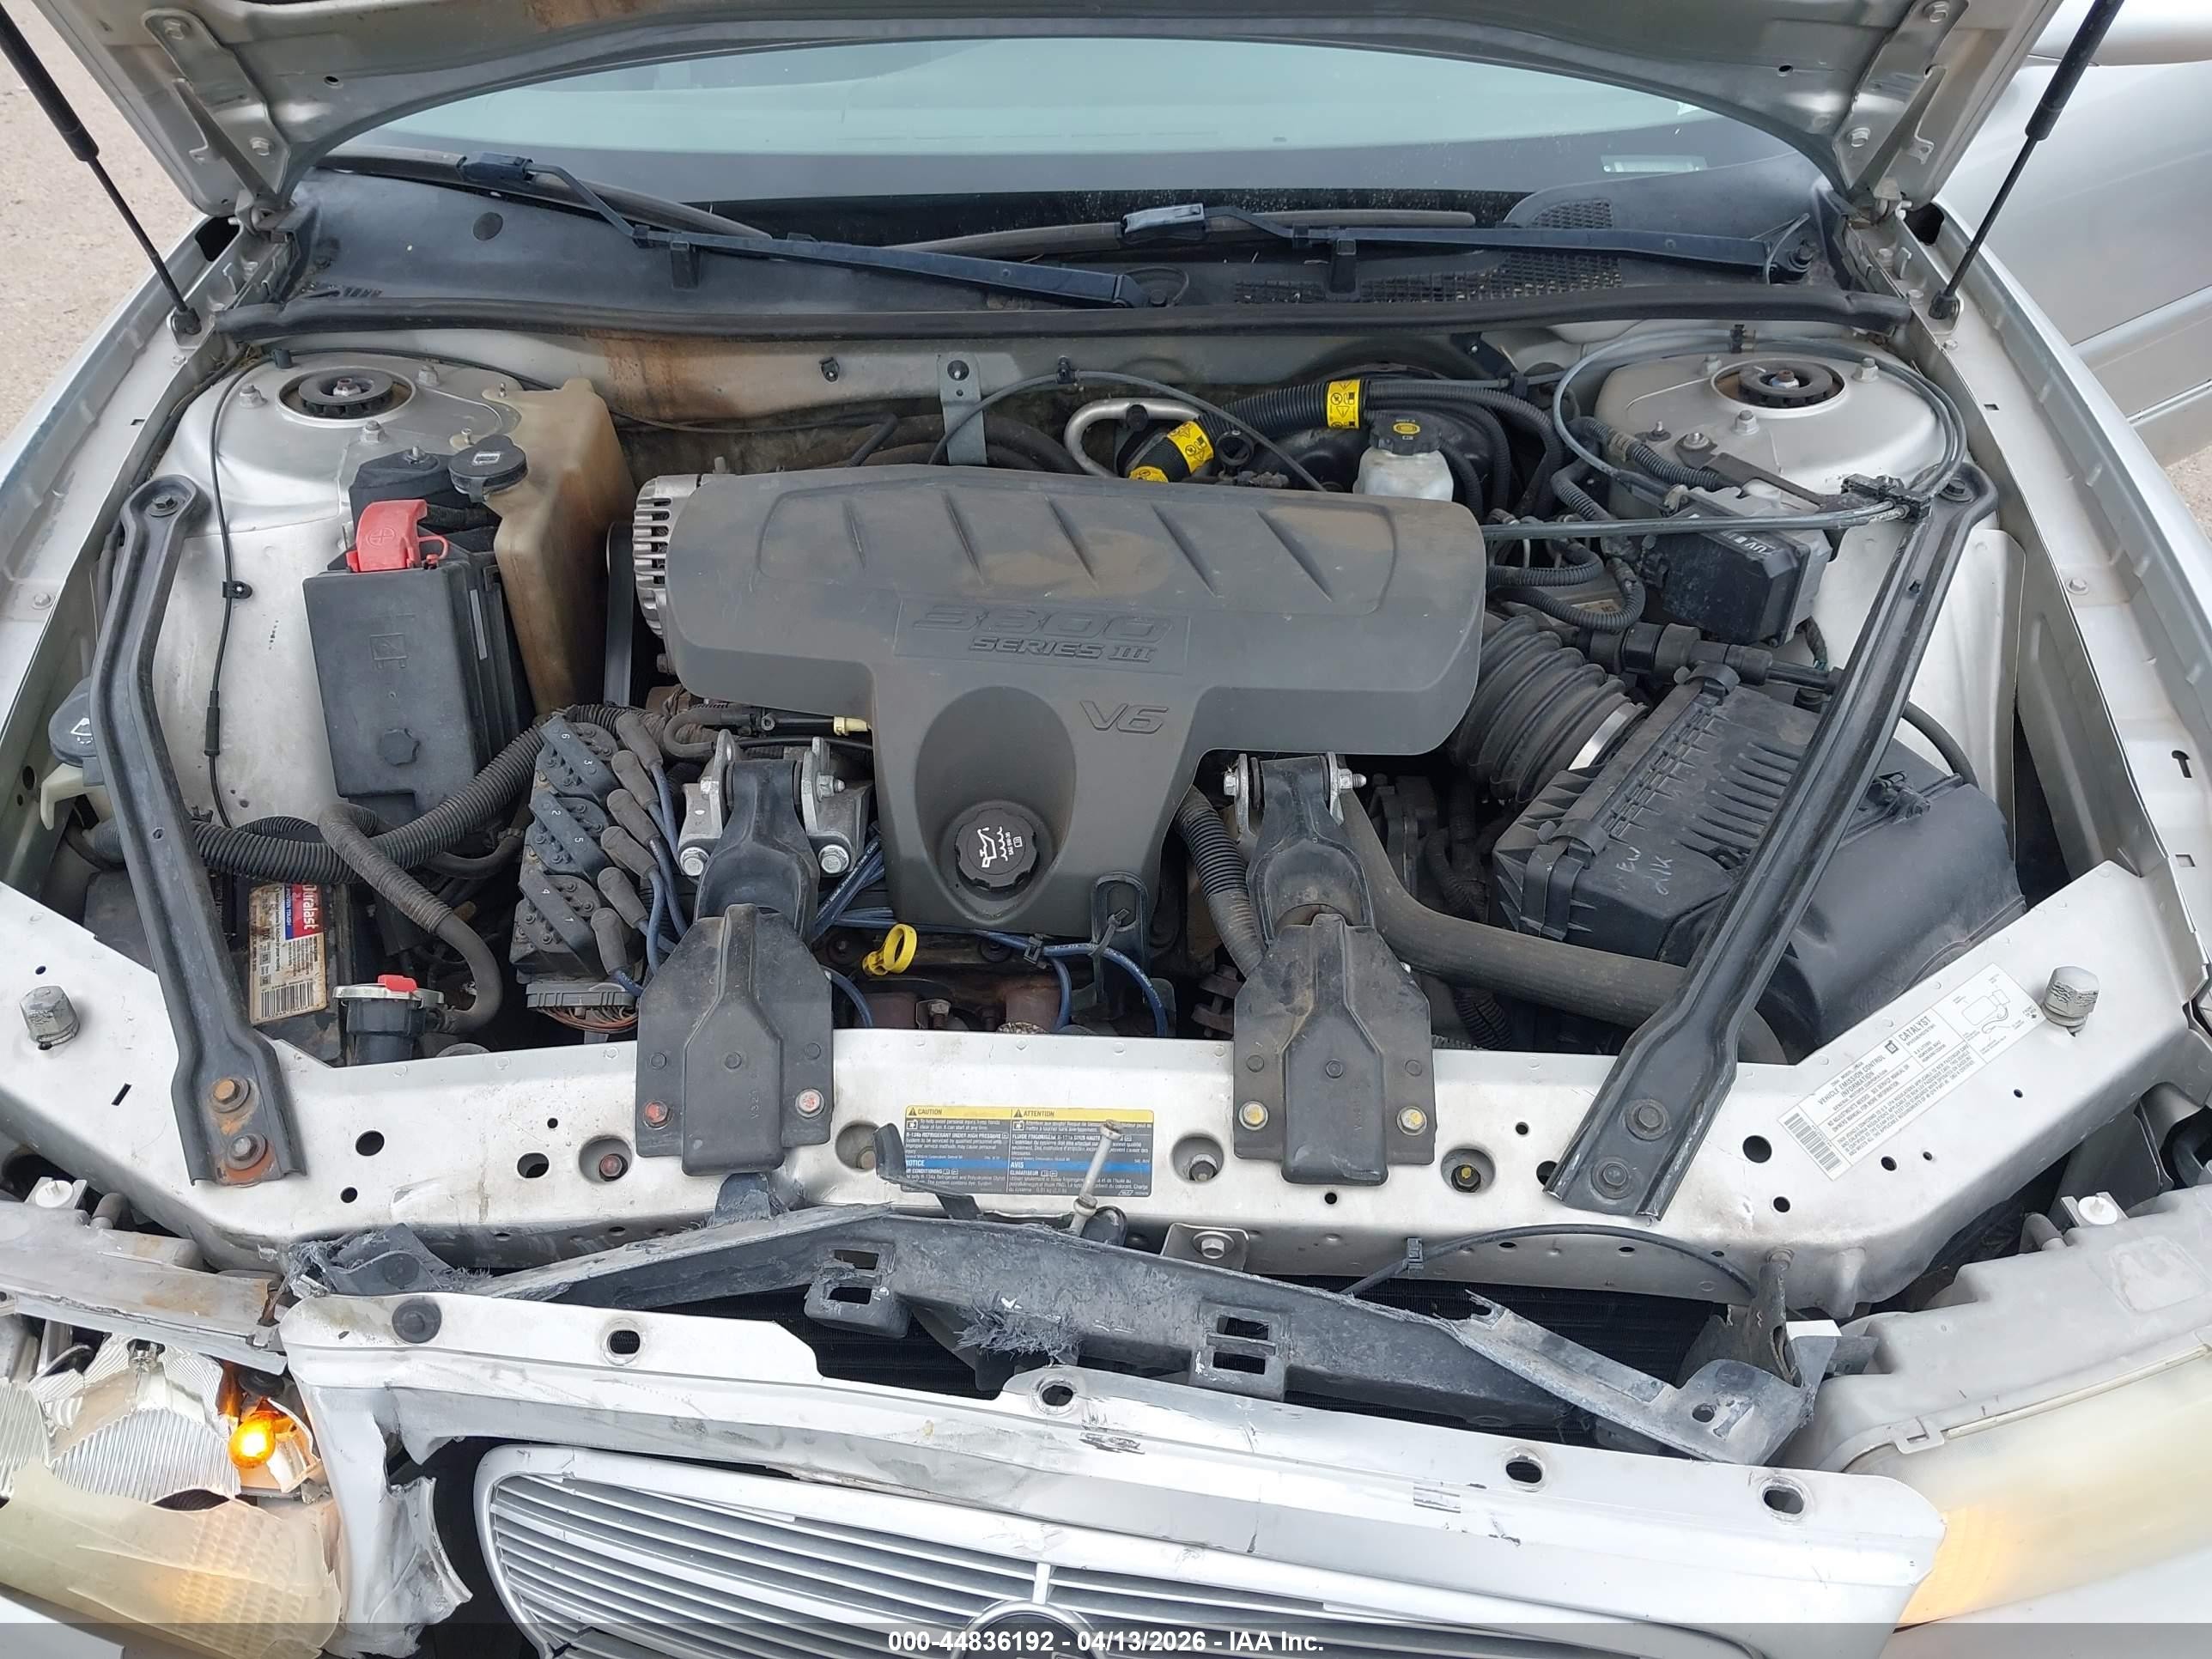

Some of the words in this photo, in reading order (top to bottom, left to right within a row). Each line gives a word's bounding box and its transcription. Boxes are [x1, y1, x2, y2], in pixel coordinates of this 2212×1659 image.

[913, 605, 1171, 643] 3800
[969, 635, 1105, 659] SERIES
[1108, 644, 1158, 663] III
[1079, 700, 1169, 734] V6
[301, 884, 319, 930] Duralast
[1897, 1014, 1932, 1042] CATALYST
[1817, 1087, 1839, 1105] VEHICLE
[1838, 1069, 1864, 1090] EMISSION
[1861, 1053, 1886, 1073] CONTROL
[1838, 1069, 1875, 1098] INFORMATION
